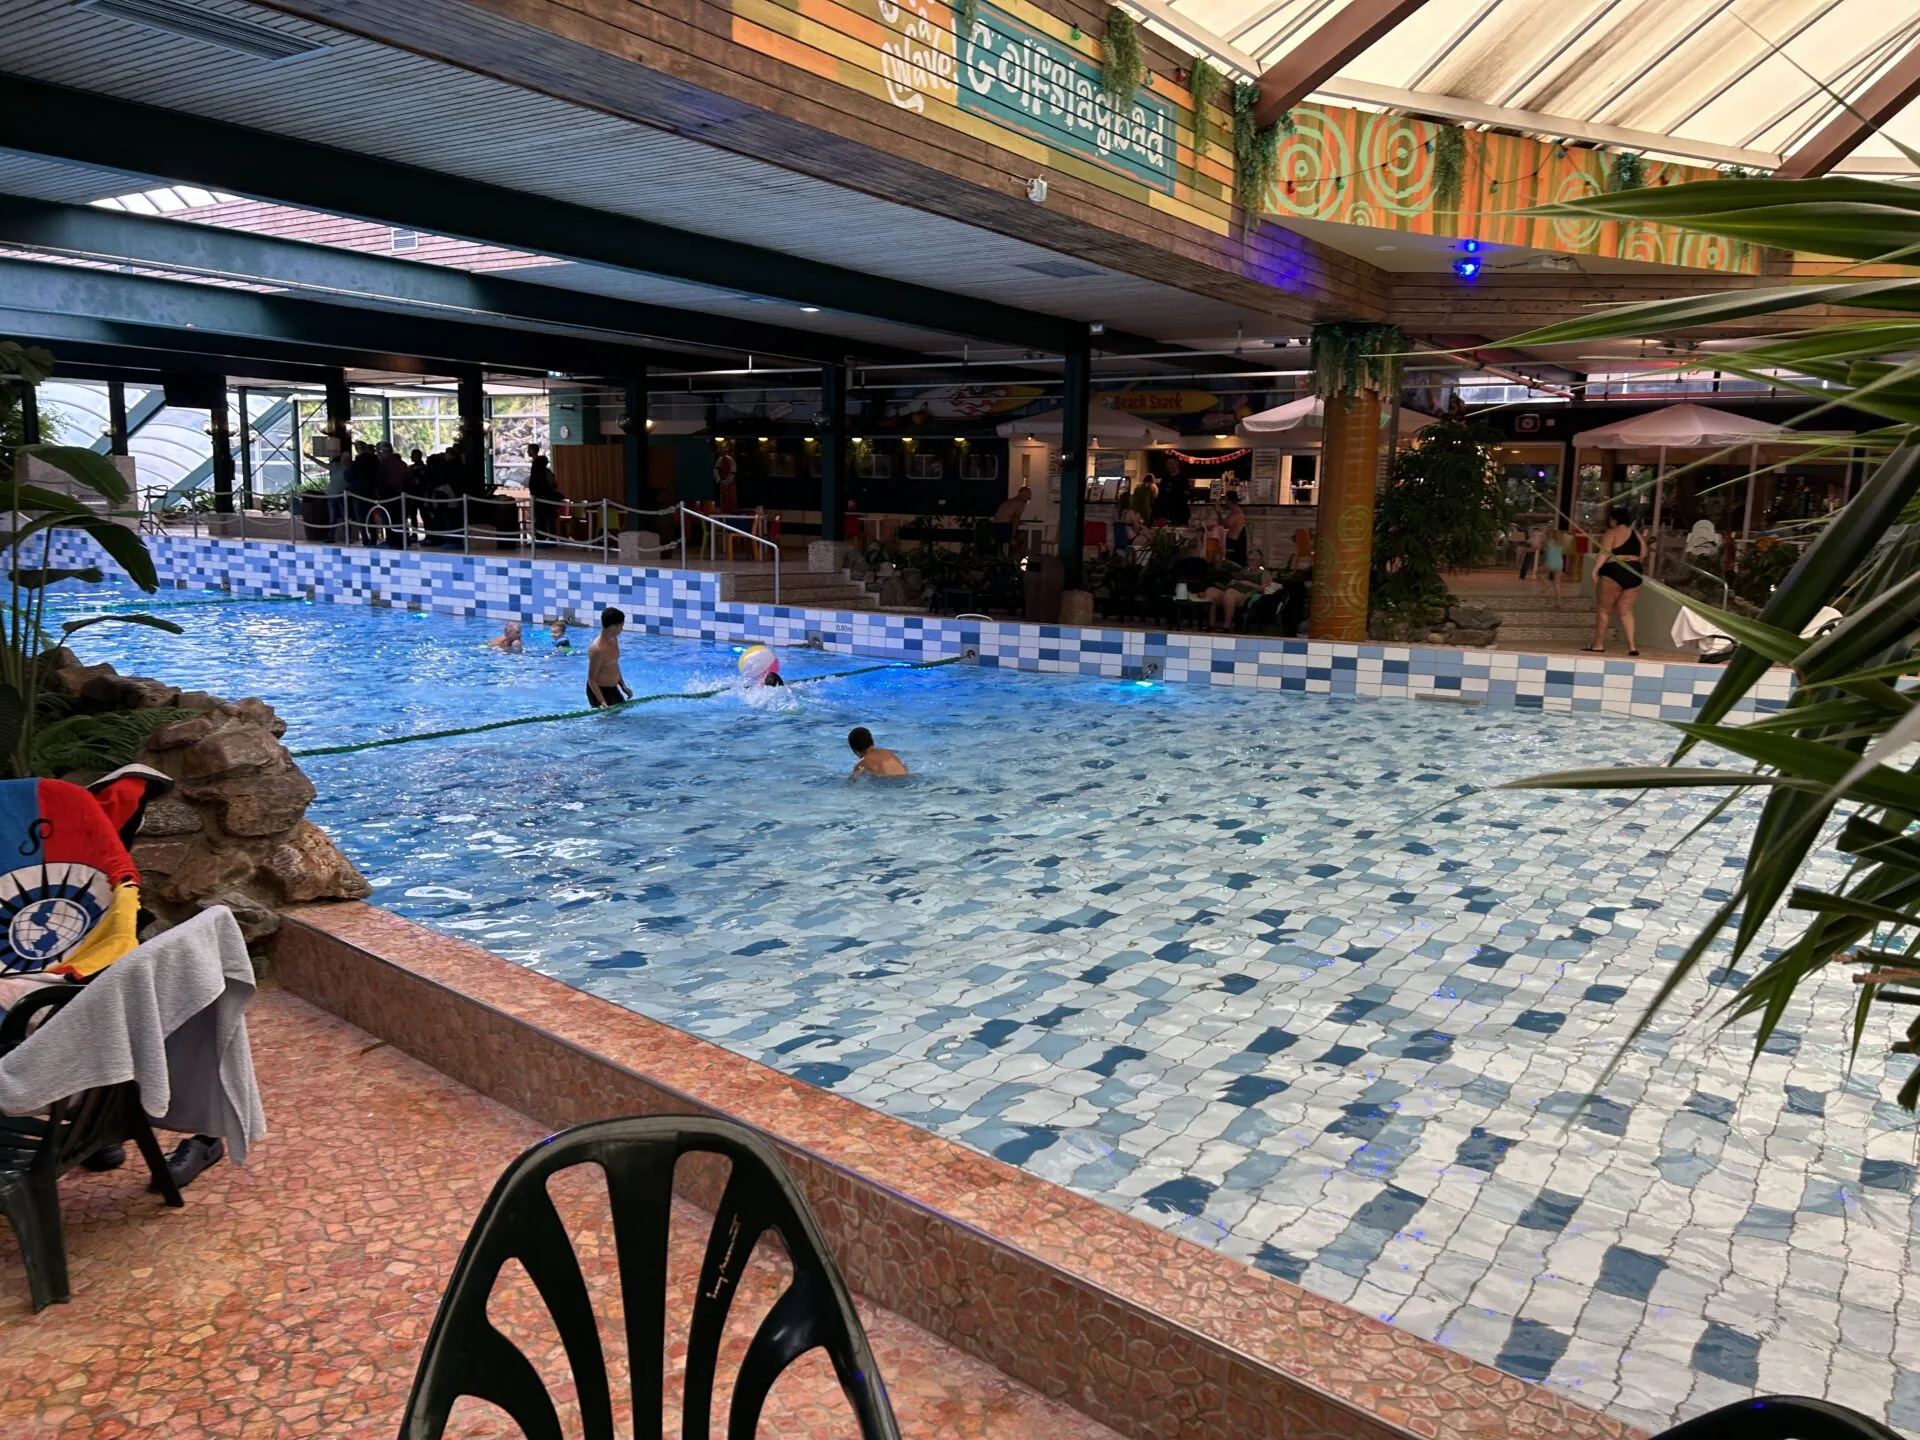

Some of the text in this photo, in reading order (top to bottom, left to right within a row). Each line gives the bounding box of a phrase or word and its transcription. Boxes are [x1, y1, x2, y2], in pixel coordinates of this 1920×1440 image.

[966, 18, 1164, 168] Golfslagbad
[1114, 392, 1183, 411] Beach Snack
